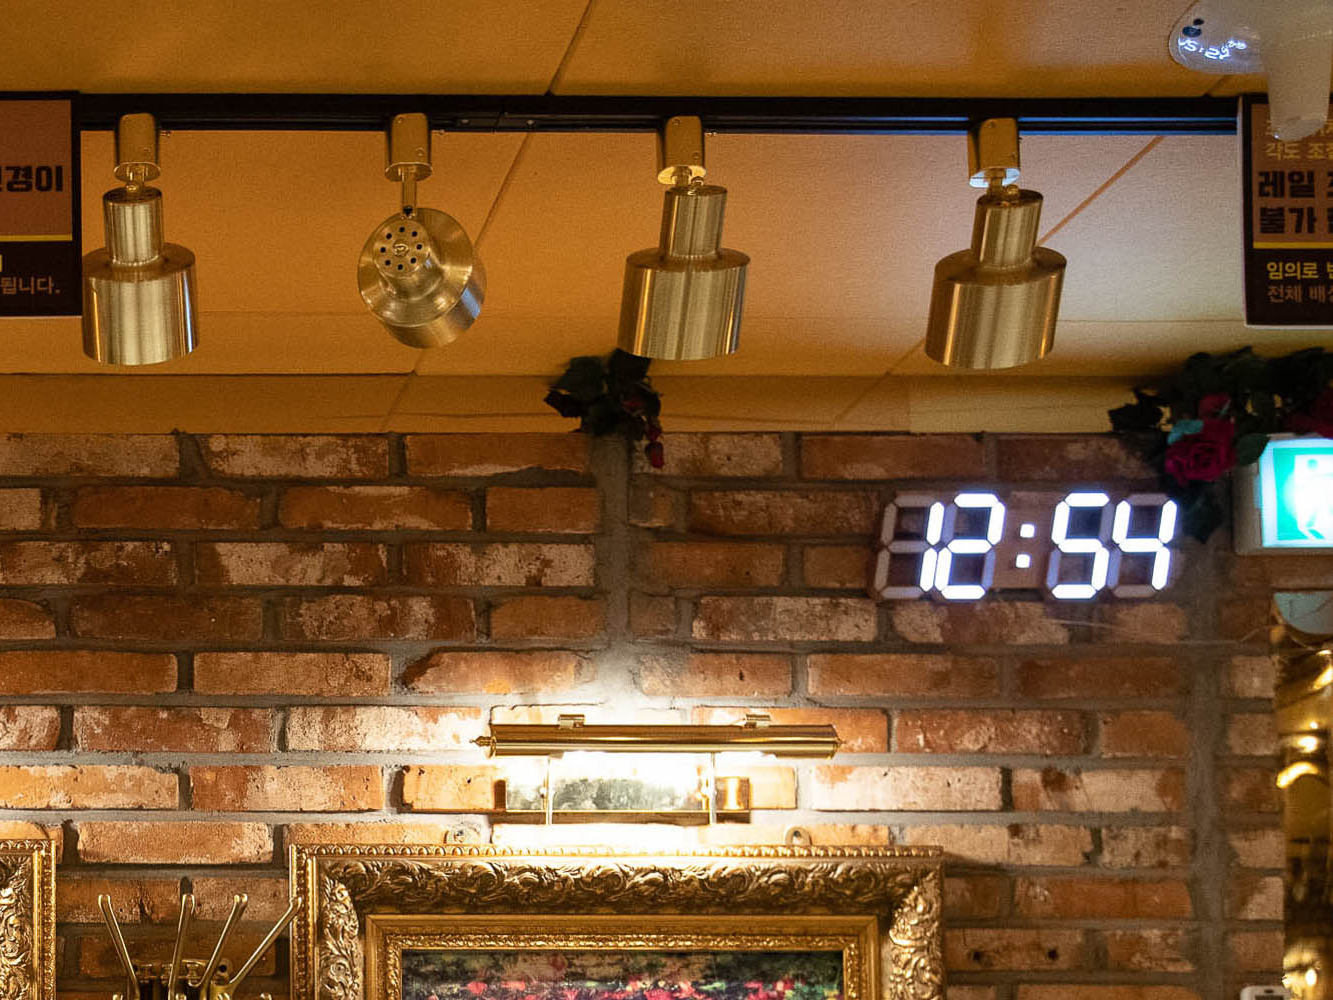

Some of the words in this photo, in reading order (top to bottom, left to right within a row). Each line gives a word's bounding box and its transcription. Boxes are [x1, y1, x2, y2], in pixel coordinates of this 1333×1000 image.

[1267, 143, 1300, 160] 각도
[1258, 171, 1315, 198] 레일
[1260, 207, 1316, 233] 불가
[1267, 262, 1319, 279] 임의로
[0, 277, 60, 294] 됩니다.
[1268, 285, 1301, 303] 전체
[918, 491, 1177, 600] 12:54
